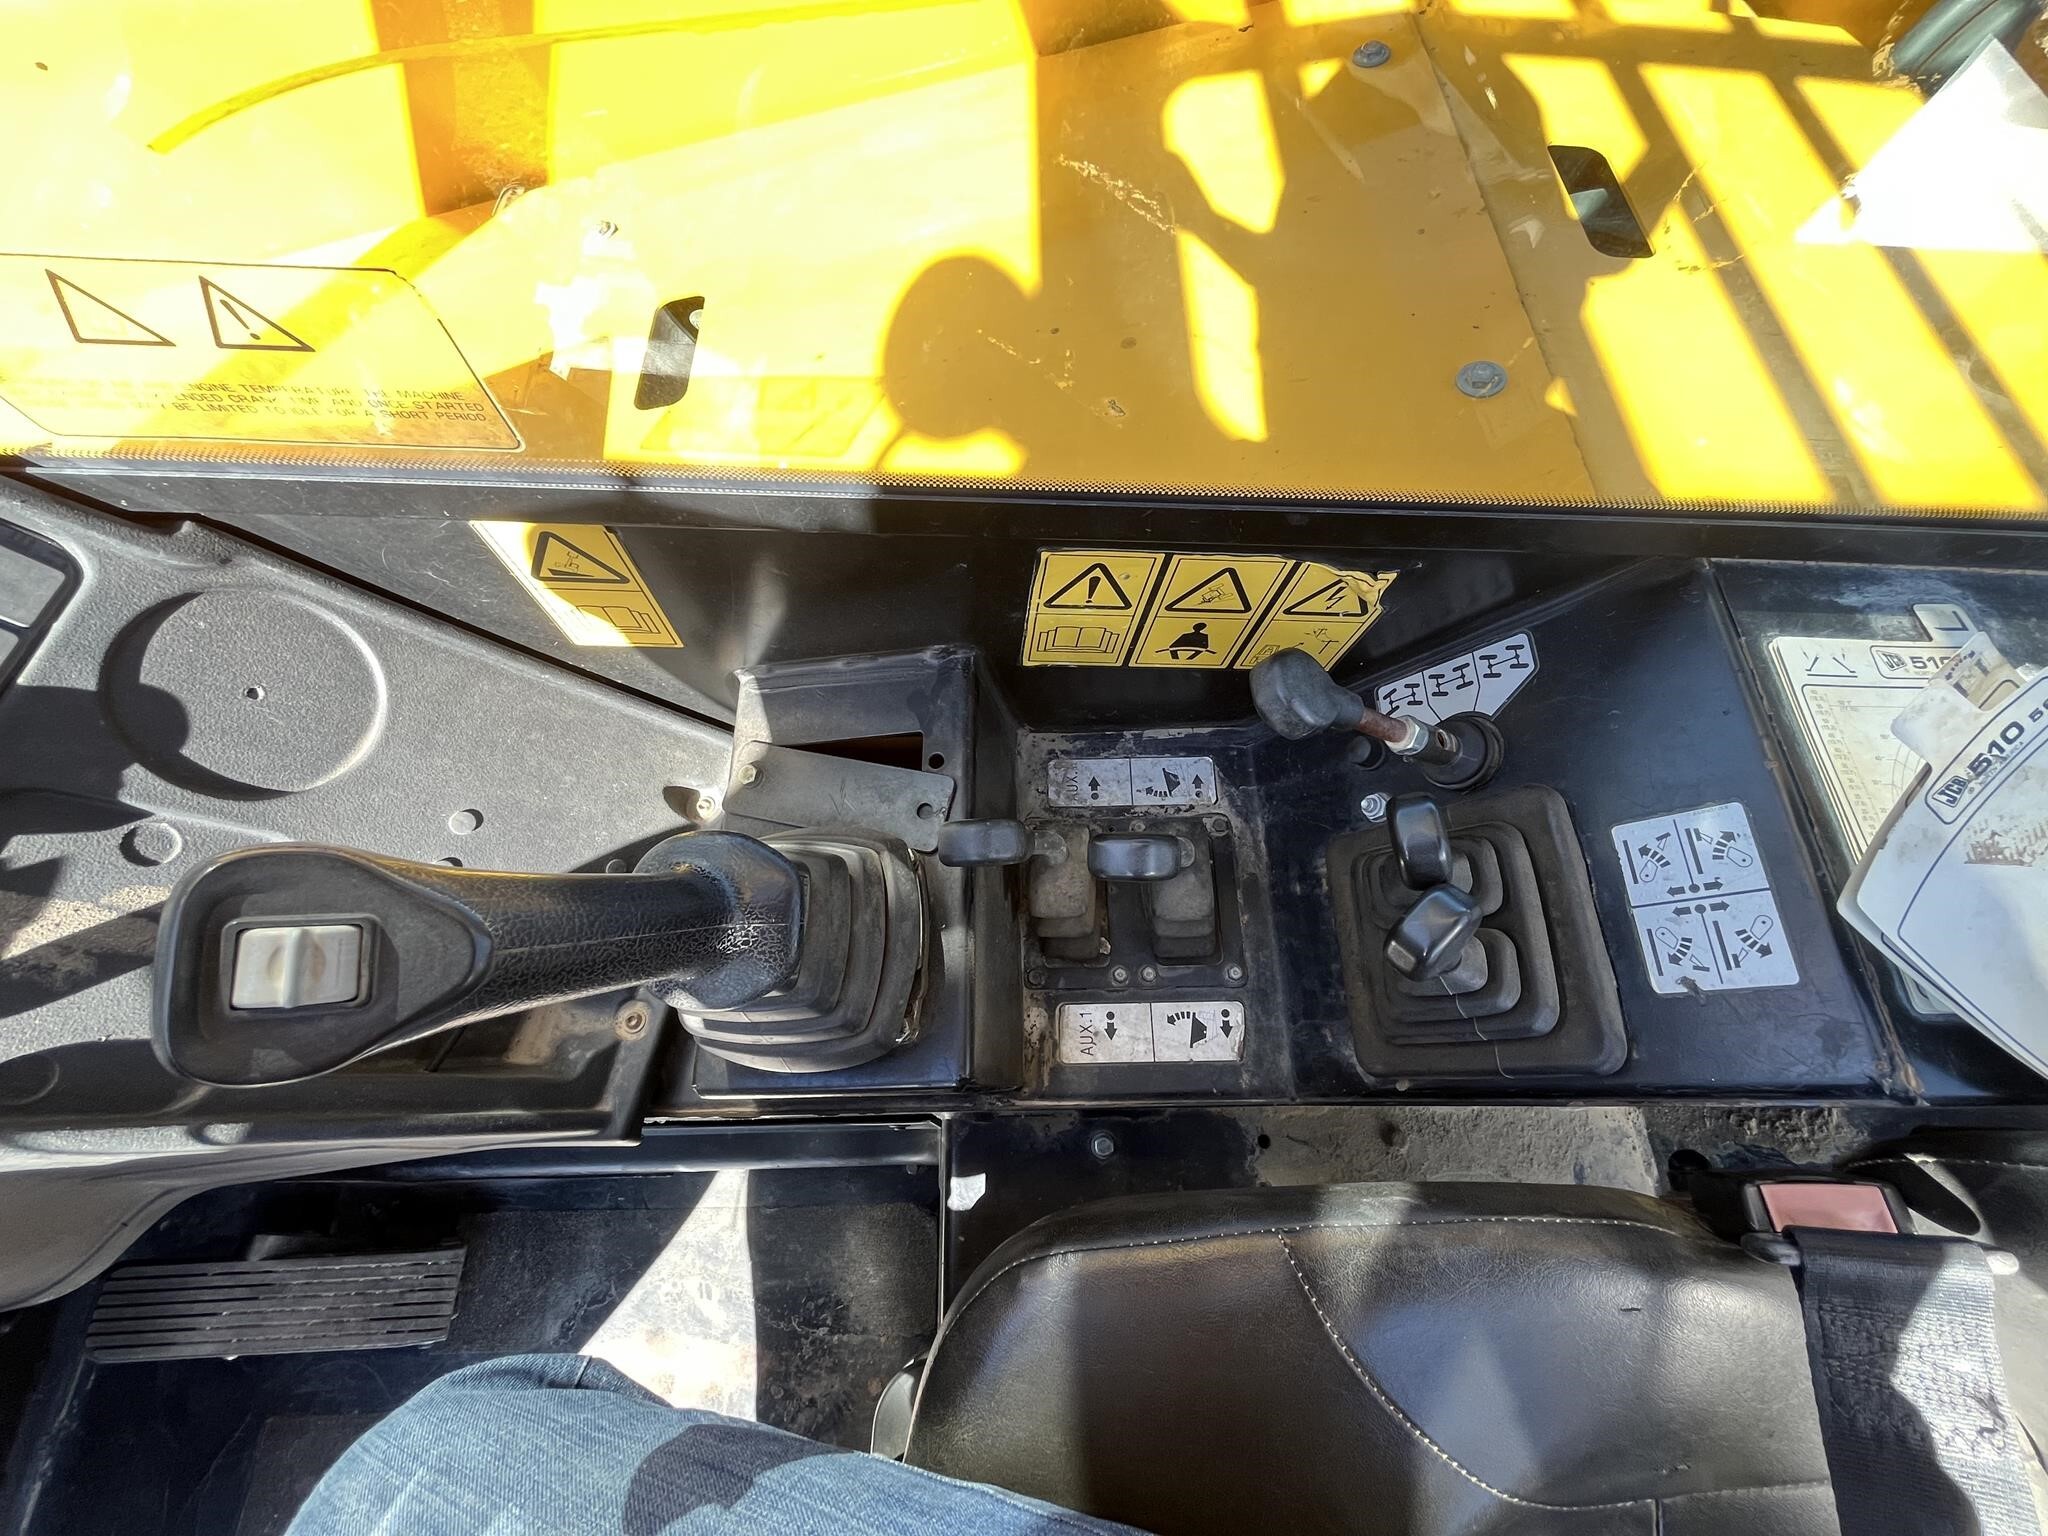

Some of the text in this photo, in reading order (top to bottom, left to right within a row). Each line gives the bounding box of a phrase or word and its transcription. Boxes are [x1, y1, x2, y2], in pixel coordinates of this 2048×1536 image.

[396, 389, 464, 401] MACHINE
[171, 402, 196, 412] BE
[196, 403, 258, 414] LIMITED
[380, 409, 430, 420] SHORT
[435, 411, 487, 422] PERIOD
[367, 399, 410, 409] ONCE
[412, 401, 485, 412] STARTED
[1935, 777, 1968, 806] JCB
[1967, 720, 2026, 777] 510
[1079, 1012, 1097, 1057] AUX.1
